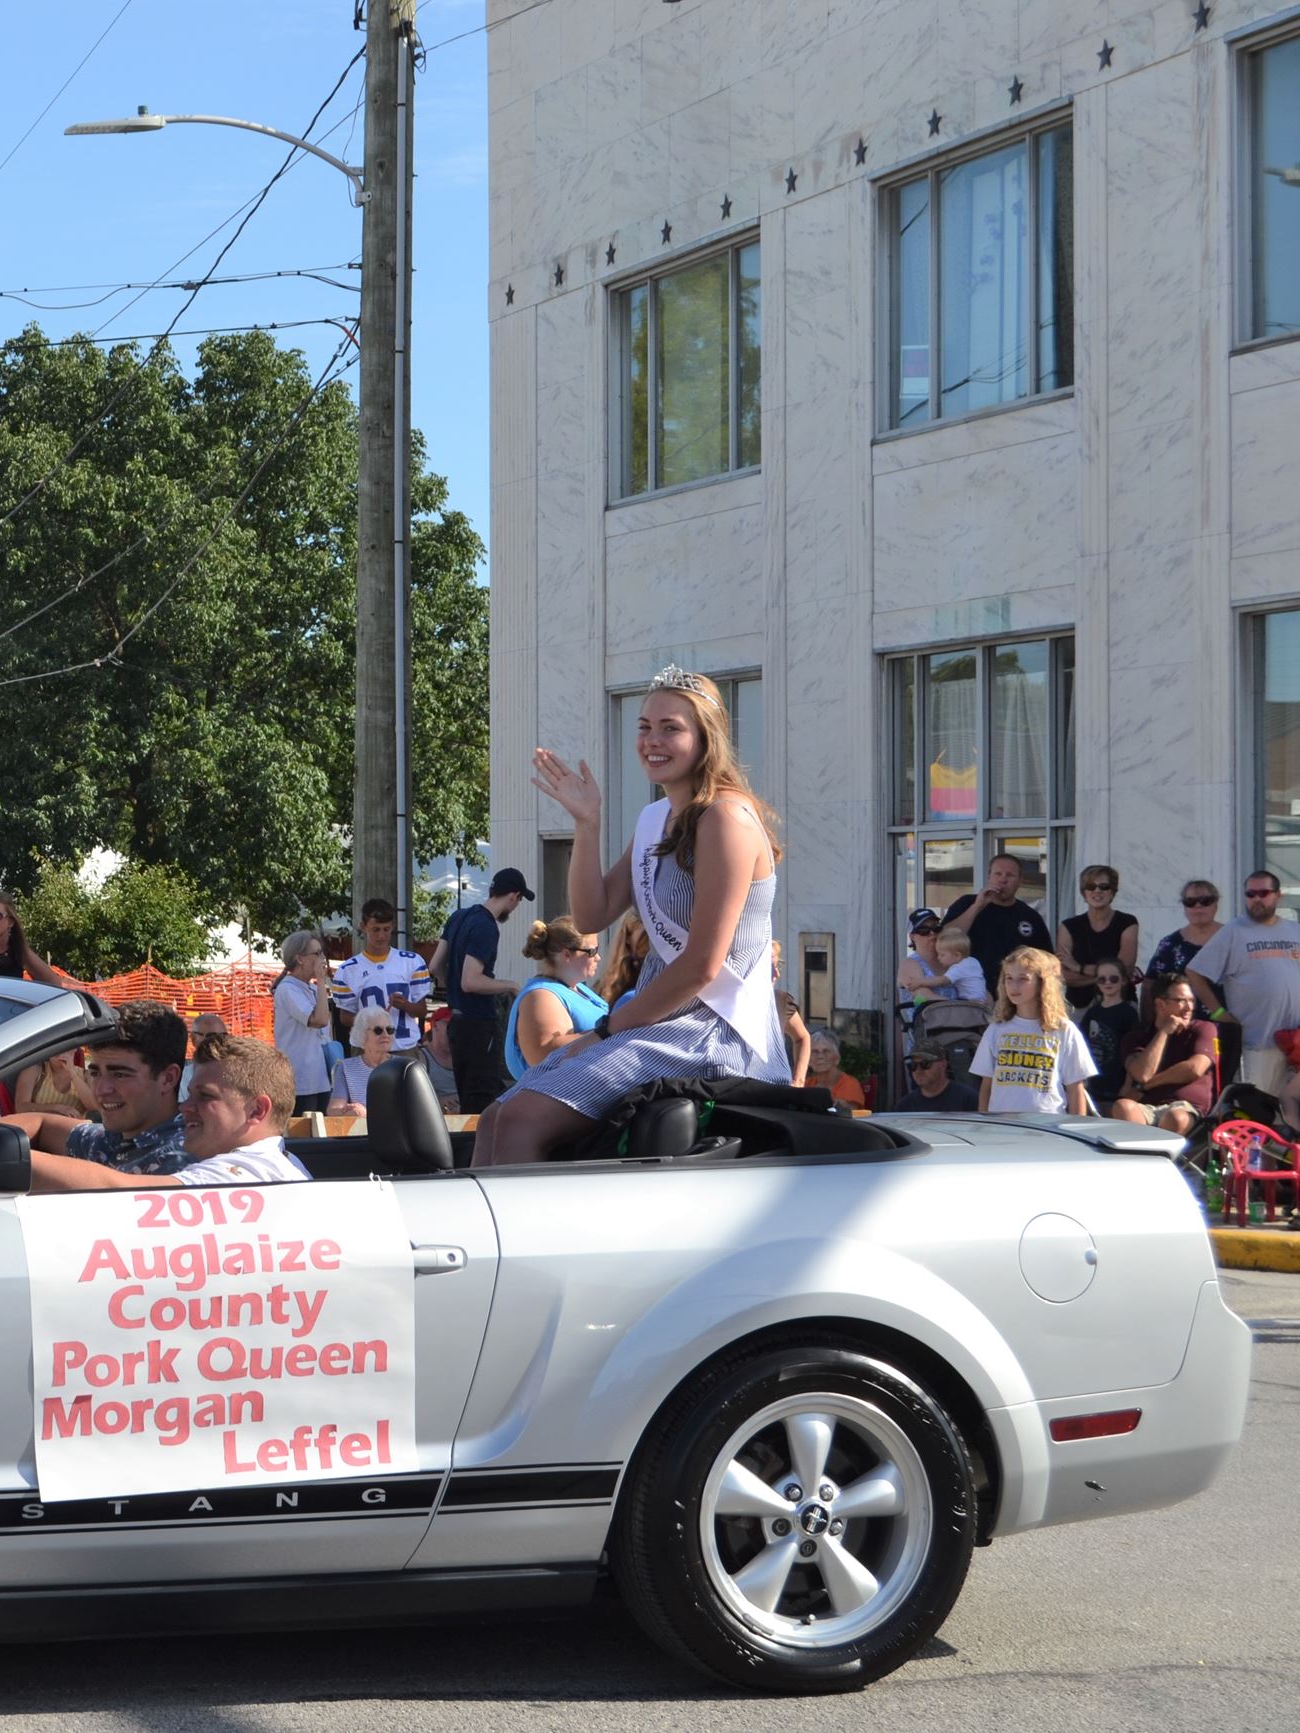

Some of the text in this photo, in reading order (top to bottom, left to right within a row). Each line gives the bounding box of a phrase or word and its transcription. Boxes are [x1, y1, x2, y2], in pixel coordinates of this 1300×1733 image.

[655, 922, 682, 952] Queen
[997, 1071, 1049, 1086] JACKETS
[998, 1052, 1054, 1069] SIDNEY
[133, 1189, 264, 1228] 2019
[78, 1233, 341, 1291] Auglaize
[108, 1284, 328, 1338] County
[52, 1337, 389, 1387] Pork Queen
[41, 1390, 264, 1446] Morgan
[223, 1420, 391, 1474] Leffel
